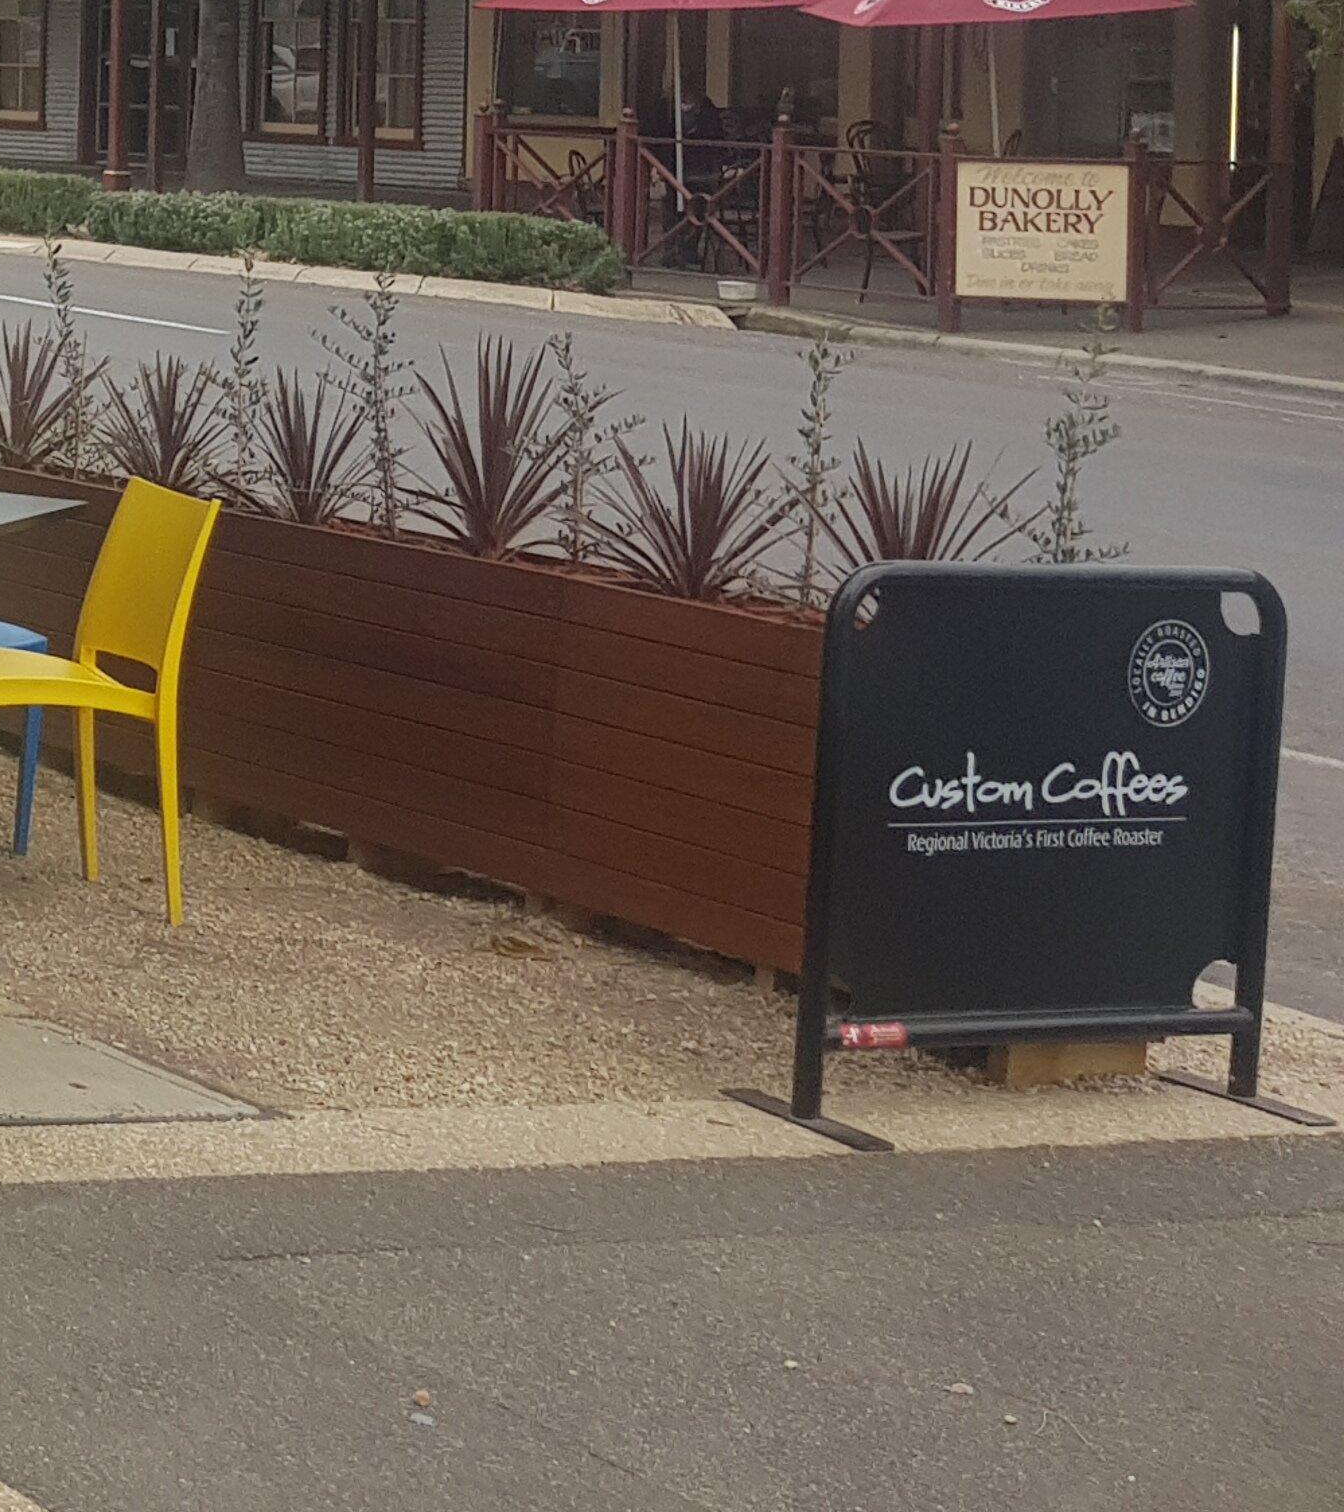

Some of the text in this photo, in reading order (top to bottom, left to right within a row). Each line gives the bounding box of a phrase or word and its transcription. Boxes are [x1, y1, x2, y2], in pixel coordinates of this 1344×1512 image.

[968, 186, 1114, 211] DUNOLLY
[978, 210, 1104, 234] BAKERY
[889, 750, 1189, 816] Custom Coffees
[907, 827, 1165, 856] Regional Victoria's First Coffee Roaster
